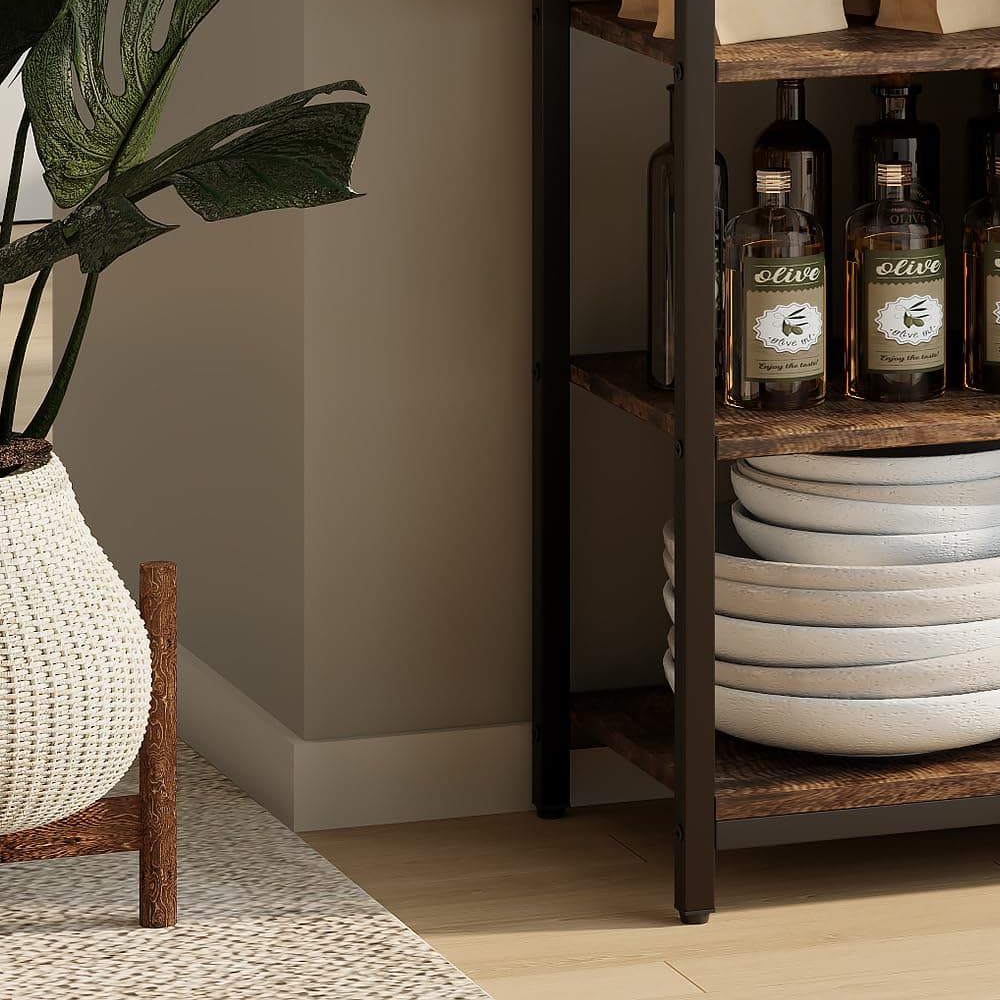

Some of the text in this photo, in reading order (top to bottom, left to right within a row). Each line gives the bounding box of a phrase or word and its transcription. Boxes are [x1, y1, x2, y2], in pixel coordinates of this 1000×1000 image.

[876, 259, 941, 276] olive
[754, 266, 821, 284] olive
[880, 354, 905, 363] Enjoy
[907, 353, 920, 361] the
[758, 362, 783, 371] Enjoy
[785, 361, 798, 369] the
